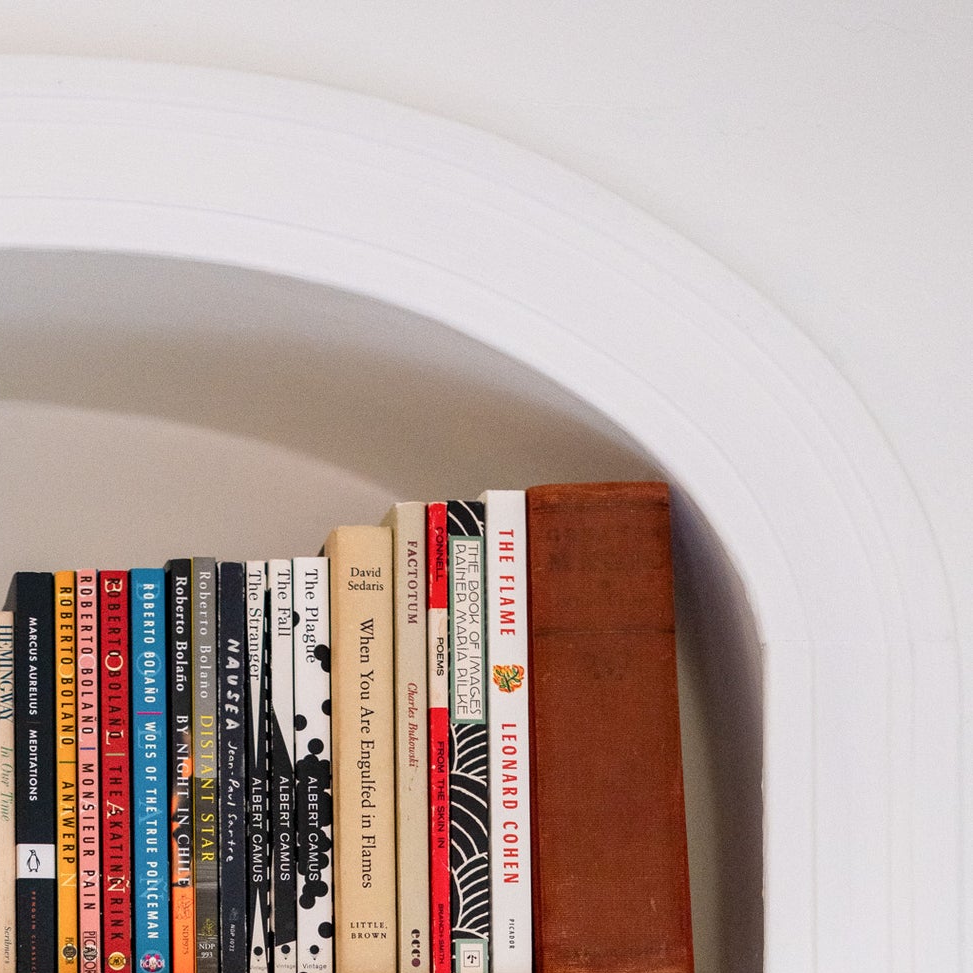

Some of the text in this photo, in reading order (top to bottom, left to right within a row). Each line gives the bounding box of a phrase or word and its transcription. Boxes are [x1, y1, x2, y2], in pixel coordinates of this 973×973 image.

[277, 569, 291, 638] The Fall
[302, 568, 319, 664] The Plague
[348, 580, 384, 591] Sedaris
[350, 567, 381, 577] David
[407, 540, 418, 625] FACTOTUM
[247, 570, 263, 682] The Stranger
[455, 544, 469, 715] RAINER MARIA RILKE
[468, 544, 482, 715] THE BOOK OF IMAGES
[28, 617, 38, 802] MARCUS AURELIUS MEDITATIONS
[59, 586, 75, 864] ROBERTO ANTWERP
[175, 575, 191, 887] Roberto Bolaño BY NIGHT IN CHILE
[198, 570, 215, 862] Roberto Bolaño DISTANT STAR
[225, 638, 240, 731] NAUSEA
[407, 682, 419, 768] Charles Bukowski
[435, 526, 446, 849] CONNELL POEMS FROM THE SKIN IN
[498, 529, 520, 884] THE FLAME LEONARD COHEN
[0, 745, 14, 758] In
[0, 763, 14, 788] Our
[80, 575, 97, 911] ROBERTO BOLAÑO MONSIEUR PAIN
[107, 577, 126, 941] ROBERTO BOLAÑO THE SKATING RINK
[142, 583, 159, 940] ROBERTO BOLAÑO WOES OF THE TRUE POLICEMAN
[357, 618, 376, 889] When You Are Engulfed in Flames
[0, 791, 14, 822] Time
[226, 813, 238, 863] Sartre
[252, 777, 263, 883] ALBERT CAMUS
[279, 775, 290, 881] ALBERT CAMUS
[307, 775, 319, 882] ALBERT CAMUS
[302, 963, 328, 971] Vintage
[508, 918, 516, 949] PICADOR
